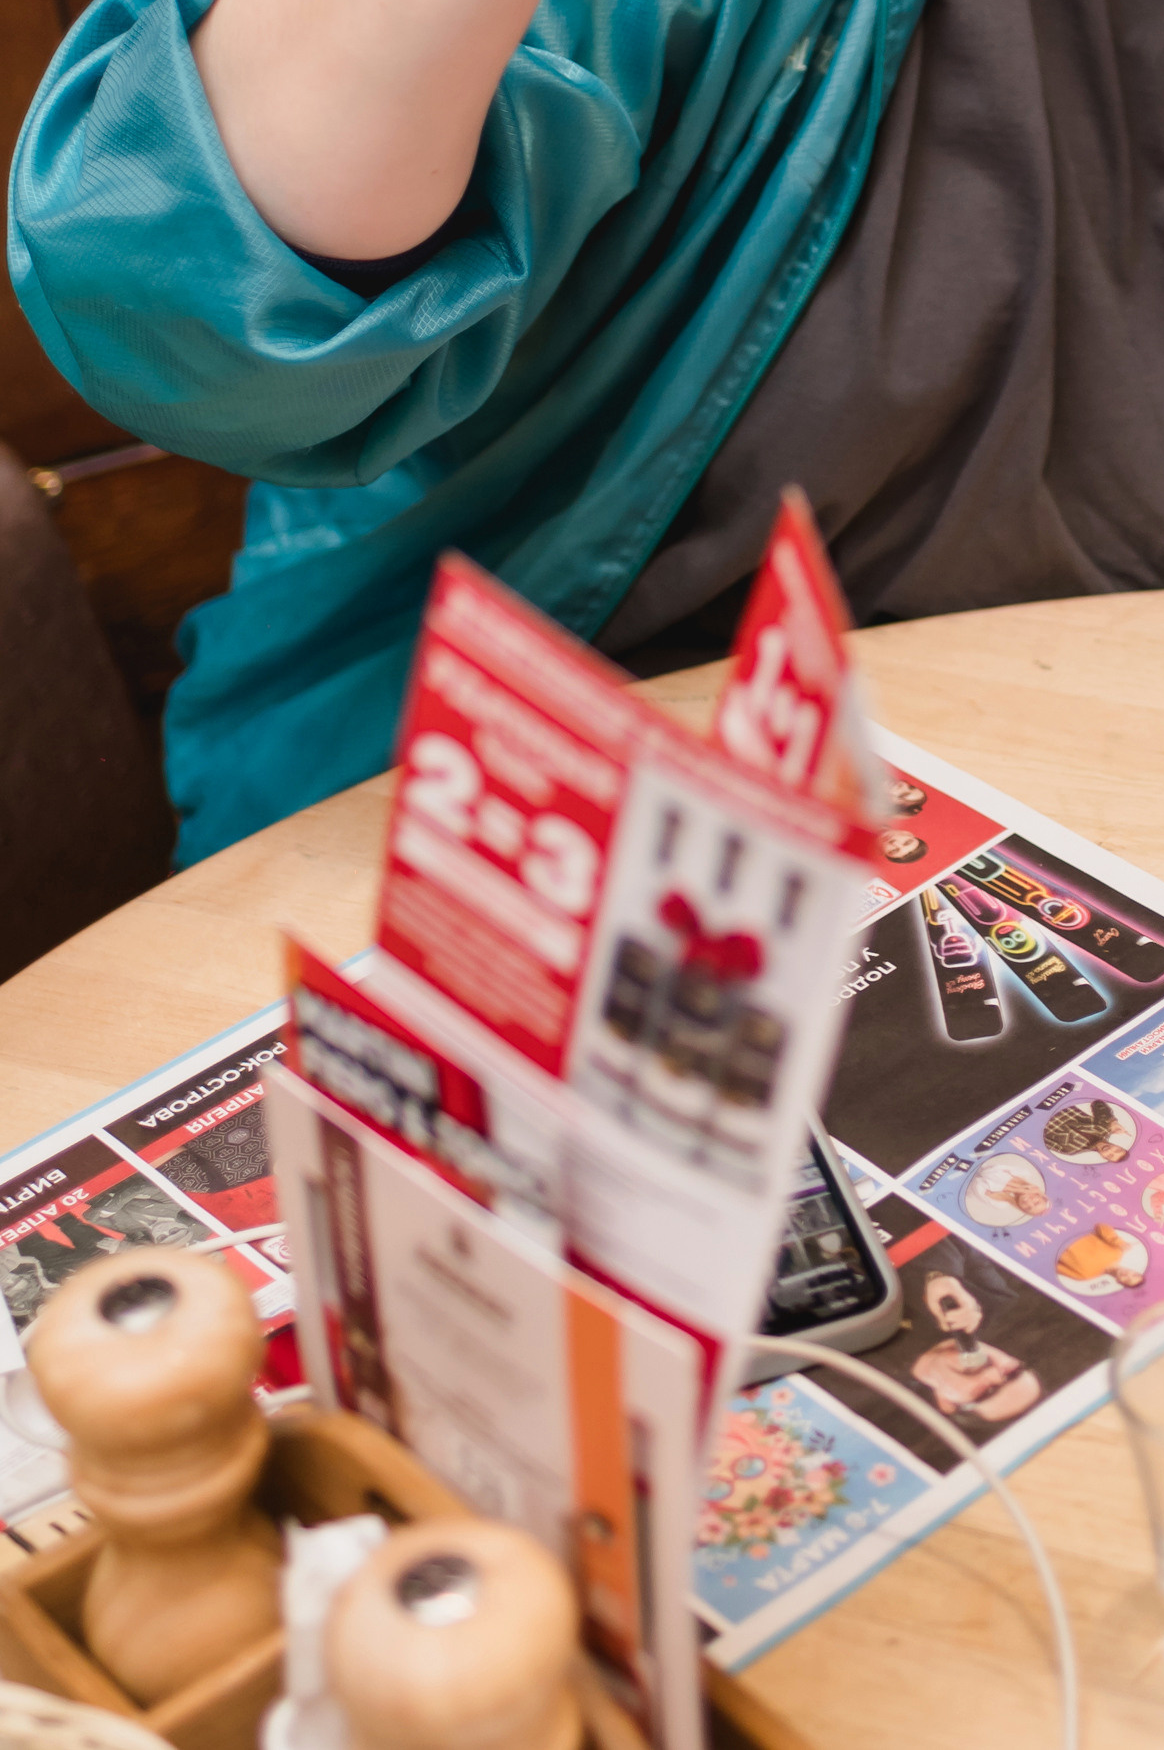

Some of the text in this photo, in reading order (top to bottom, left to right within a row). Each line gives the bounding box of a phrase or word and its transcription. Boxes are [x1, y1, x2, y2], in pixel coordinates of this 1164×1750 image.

[137, 1042, 288, 1128] РОК-ОСТРОВА
[1042, 1086, 1069, 1107] ВЕЧЕР
[185, 1084, 264, 1133] АПРЕЛЯ
[920, 1155, 955, 1190] ФЛИРТА
[62, 1188, 89, 1206] 20
